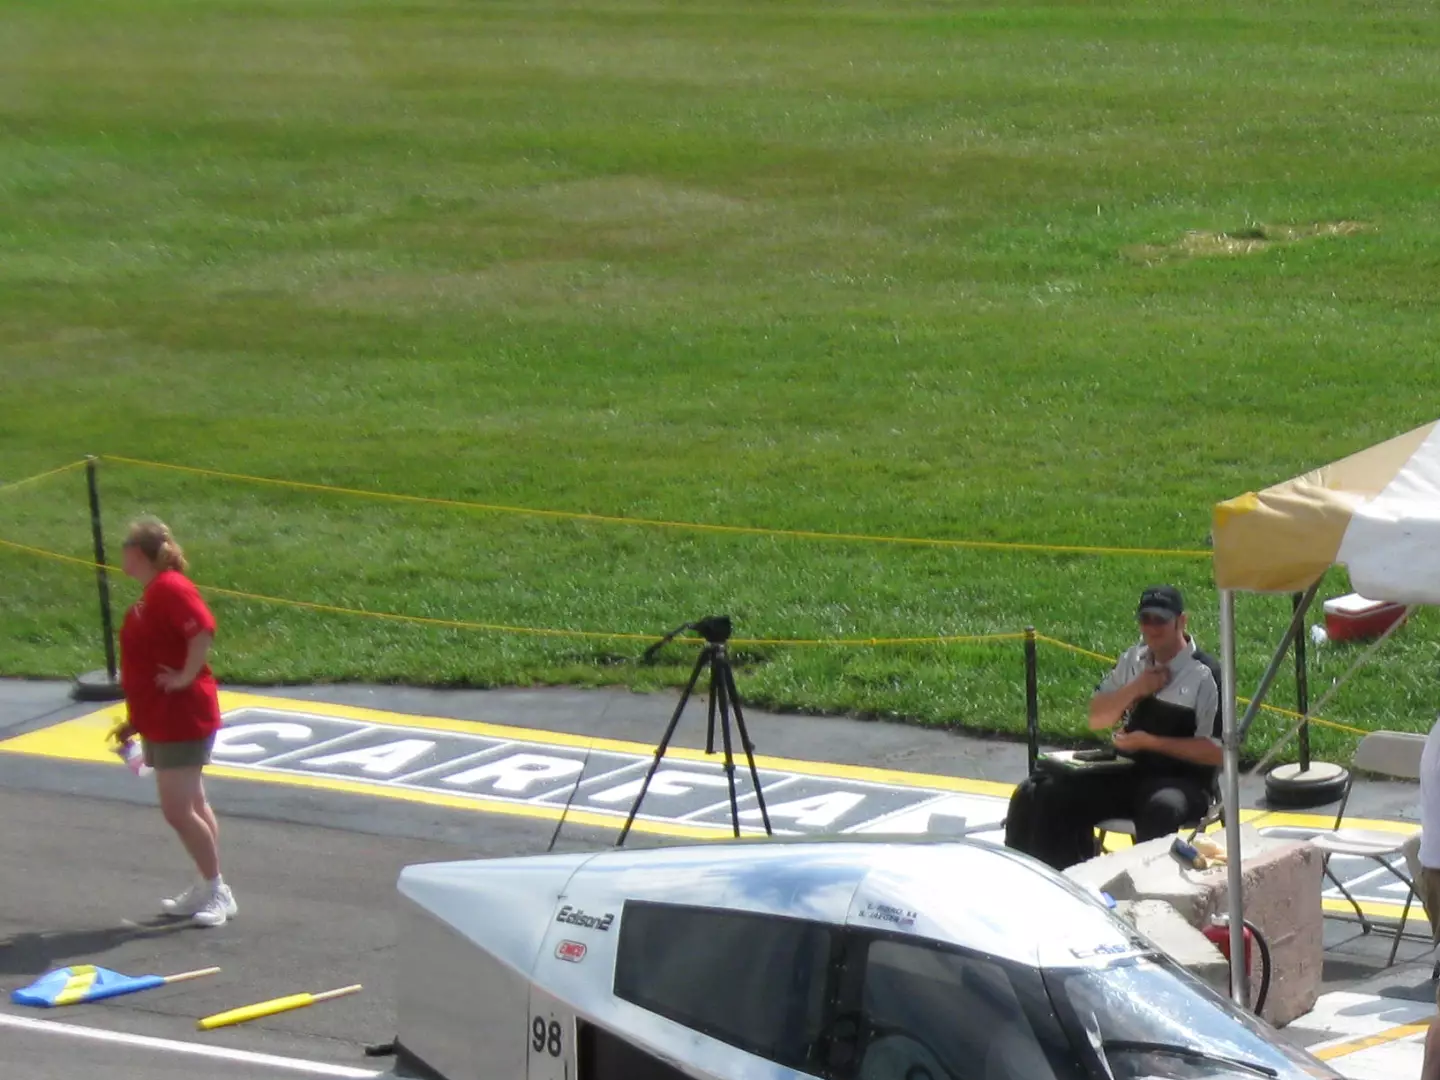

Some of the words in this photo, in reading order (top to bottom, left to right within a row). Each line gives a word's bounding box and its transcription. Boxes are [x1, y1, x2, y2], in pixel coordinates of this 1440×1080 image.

[211, 722, 868, 828] CARFA
[556, 905, 615, 932] Edison2
[532, 1015, 562, 1058] 98
